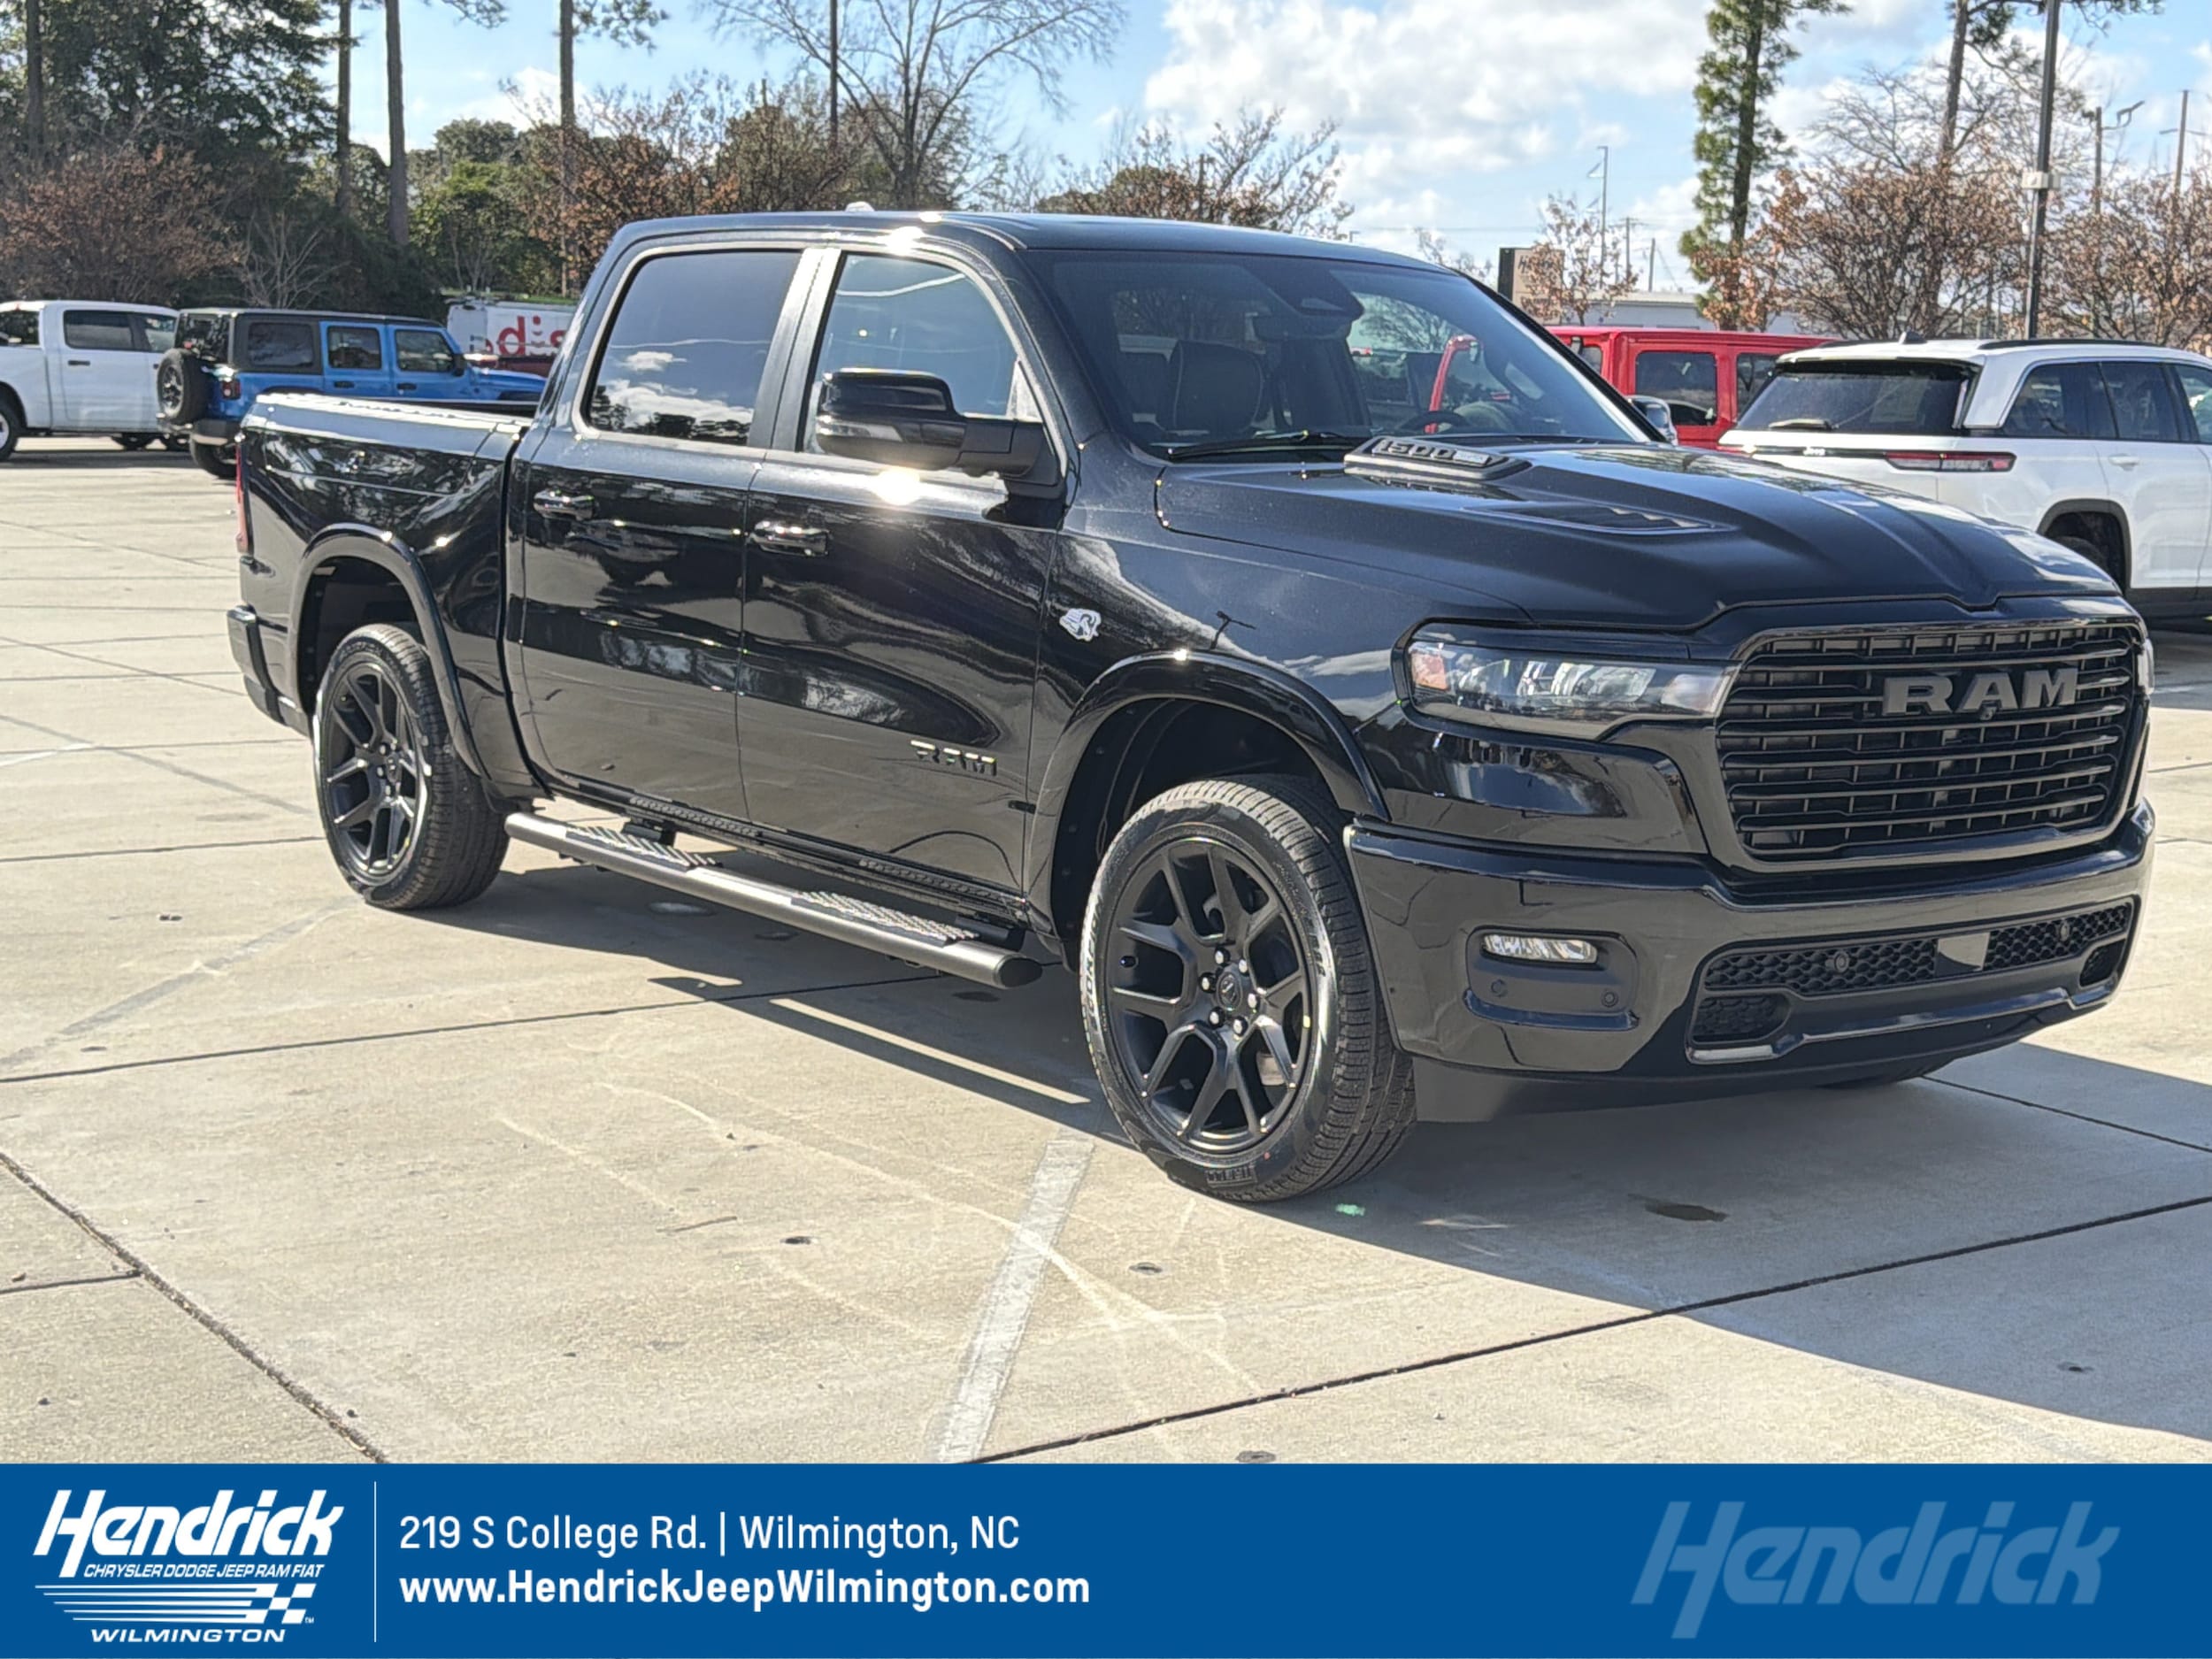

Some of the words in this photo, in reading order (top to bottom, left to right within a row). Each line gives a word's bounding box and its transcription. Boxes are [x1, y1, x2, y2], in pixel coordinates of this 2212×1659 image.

[1371, 439, 1454, 460] 1500
[1881, 667, 2079, 718] RAM
[910, 740, 998, 776] RAM
